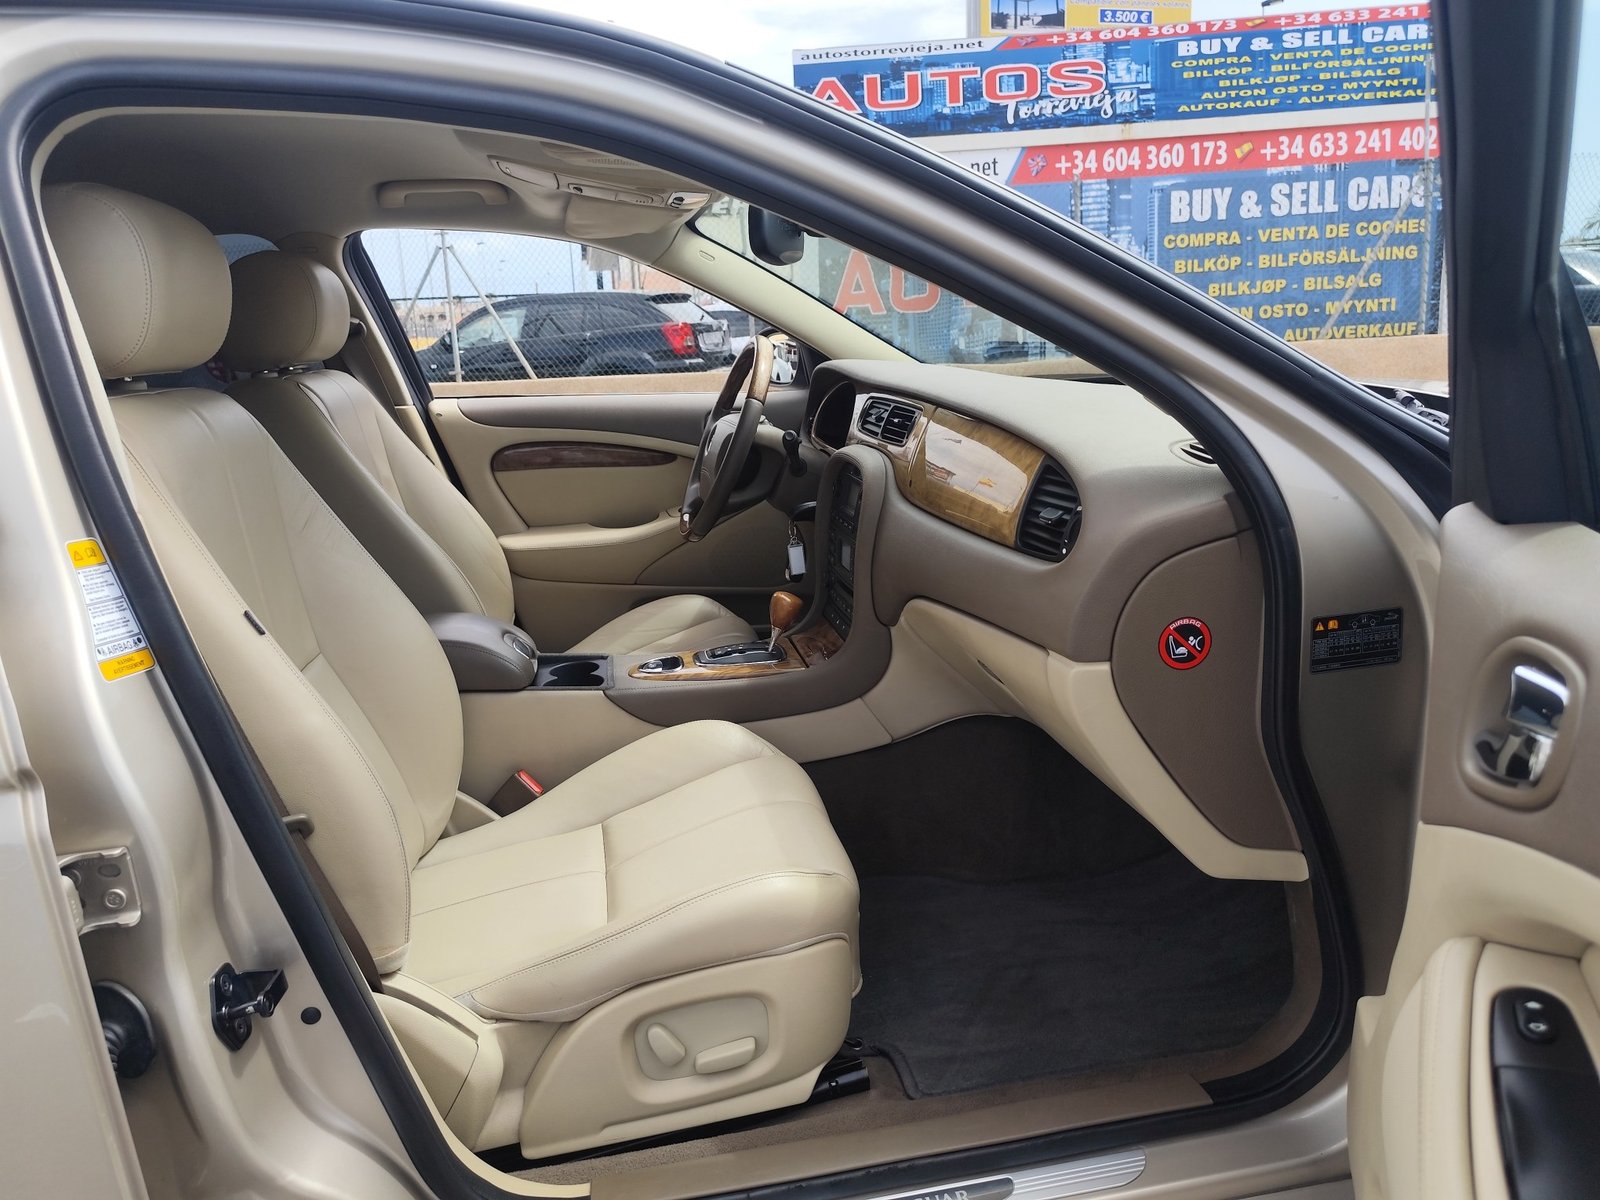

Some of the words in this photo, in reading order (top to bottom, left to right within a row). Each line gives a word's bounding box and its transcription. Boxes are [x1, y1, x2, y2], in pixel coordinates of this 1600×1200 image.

[1047, 30, 1093, 44] +34
[1099, 27, 1141, 39] 604
[1147, 24, 1190, 36] 360
[1197, 20, 1237, 32] 173
[1274, 12, 1322, 26] +34
[1328, 9, 1370, 22] 633
[1378, 6, 1419, 19] 241
[1104, 10, 1138, 23] 3.500
[1140, 12, 1150, 23] €
[801, 39, 984, 61] autostorrevieja.net
[1178, 36, 1242, 57] BUY
[1250, 36, 1273, 51] &
[1282, 22, 1353, 49] SELL
[1362, 23, 1432, 43] CAR
[1171, 55, 1251, 68] COMPRA
[1271, 50, 1333, 60] VENTA
[1341, 47, 1365, 56] DE
[1183, 66, 1252, 79] BILKÖP
[1271, 54, 1425, 73] BILFÖRSÄLJNIN
[810, 59, 1107, 114] AUTOS
[1201, 88, 1266, 100] AUTON
[1273, 83, 1324, 95] OSTO
[1342, 78, 1418, 90] MYYNTI
[1218, 74, 1302, 88] BILKJØP
[1319, 67, 1401, 80] BILSALG
[1000, 89, 1136, 124] Torrevieja
[1177, 98, 1280, 112] AUTOKAUF
[1055, 150, 1098, 176] +34
[1100, 147, 1141, 173] 604
[1147, 143, 1184, 170] 360
[1191, 140, 1227, 165] 173
[1260, 135, 1303, 162] +34
[1309, 131, 1349, 158] 633
[1355, 128, 1391, 154] 241
[1399, 125, 1437, 151] 402
[1170, 186, 1232, 223] BUY
[1239, 190, 1262, 219] &
[1270, 179, 1339, 217] SELL
[1347, 174, 1425, 211] CARS
[1164, 231, 1241, 250] COMPRA
[1258, 225, 1319, 243] VENTA
[1326, 221, 1349, 238] DE
[1174, 254, 1242, 273] BILKÖP
[1258, 245, 1418, 269] BILFÖRSÄLJNING
[1208, 279, 1287, 297] BILKJØP
[1304, 272, 1382, 291] BILSALG
[1259, 303, 1308, 319] OSTO
[1325, 298, 1396, 315] MYYNTI
[1283, 322, 1418, 342] AUTOVERKAUF
[1169, 618, 1202, 630] AIRBAG
